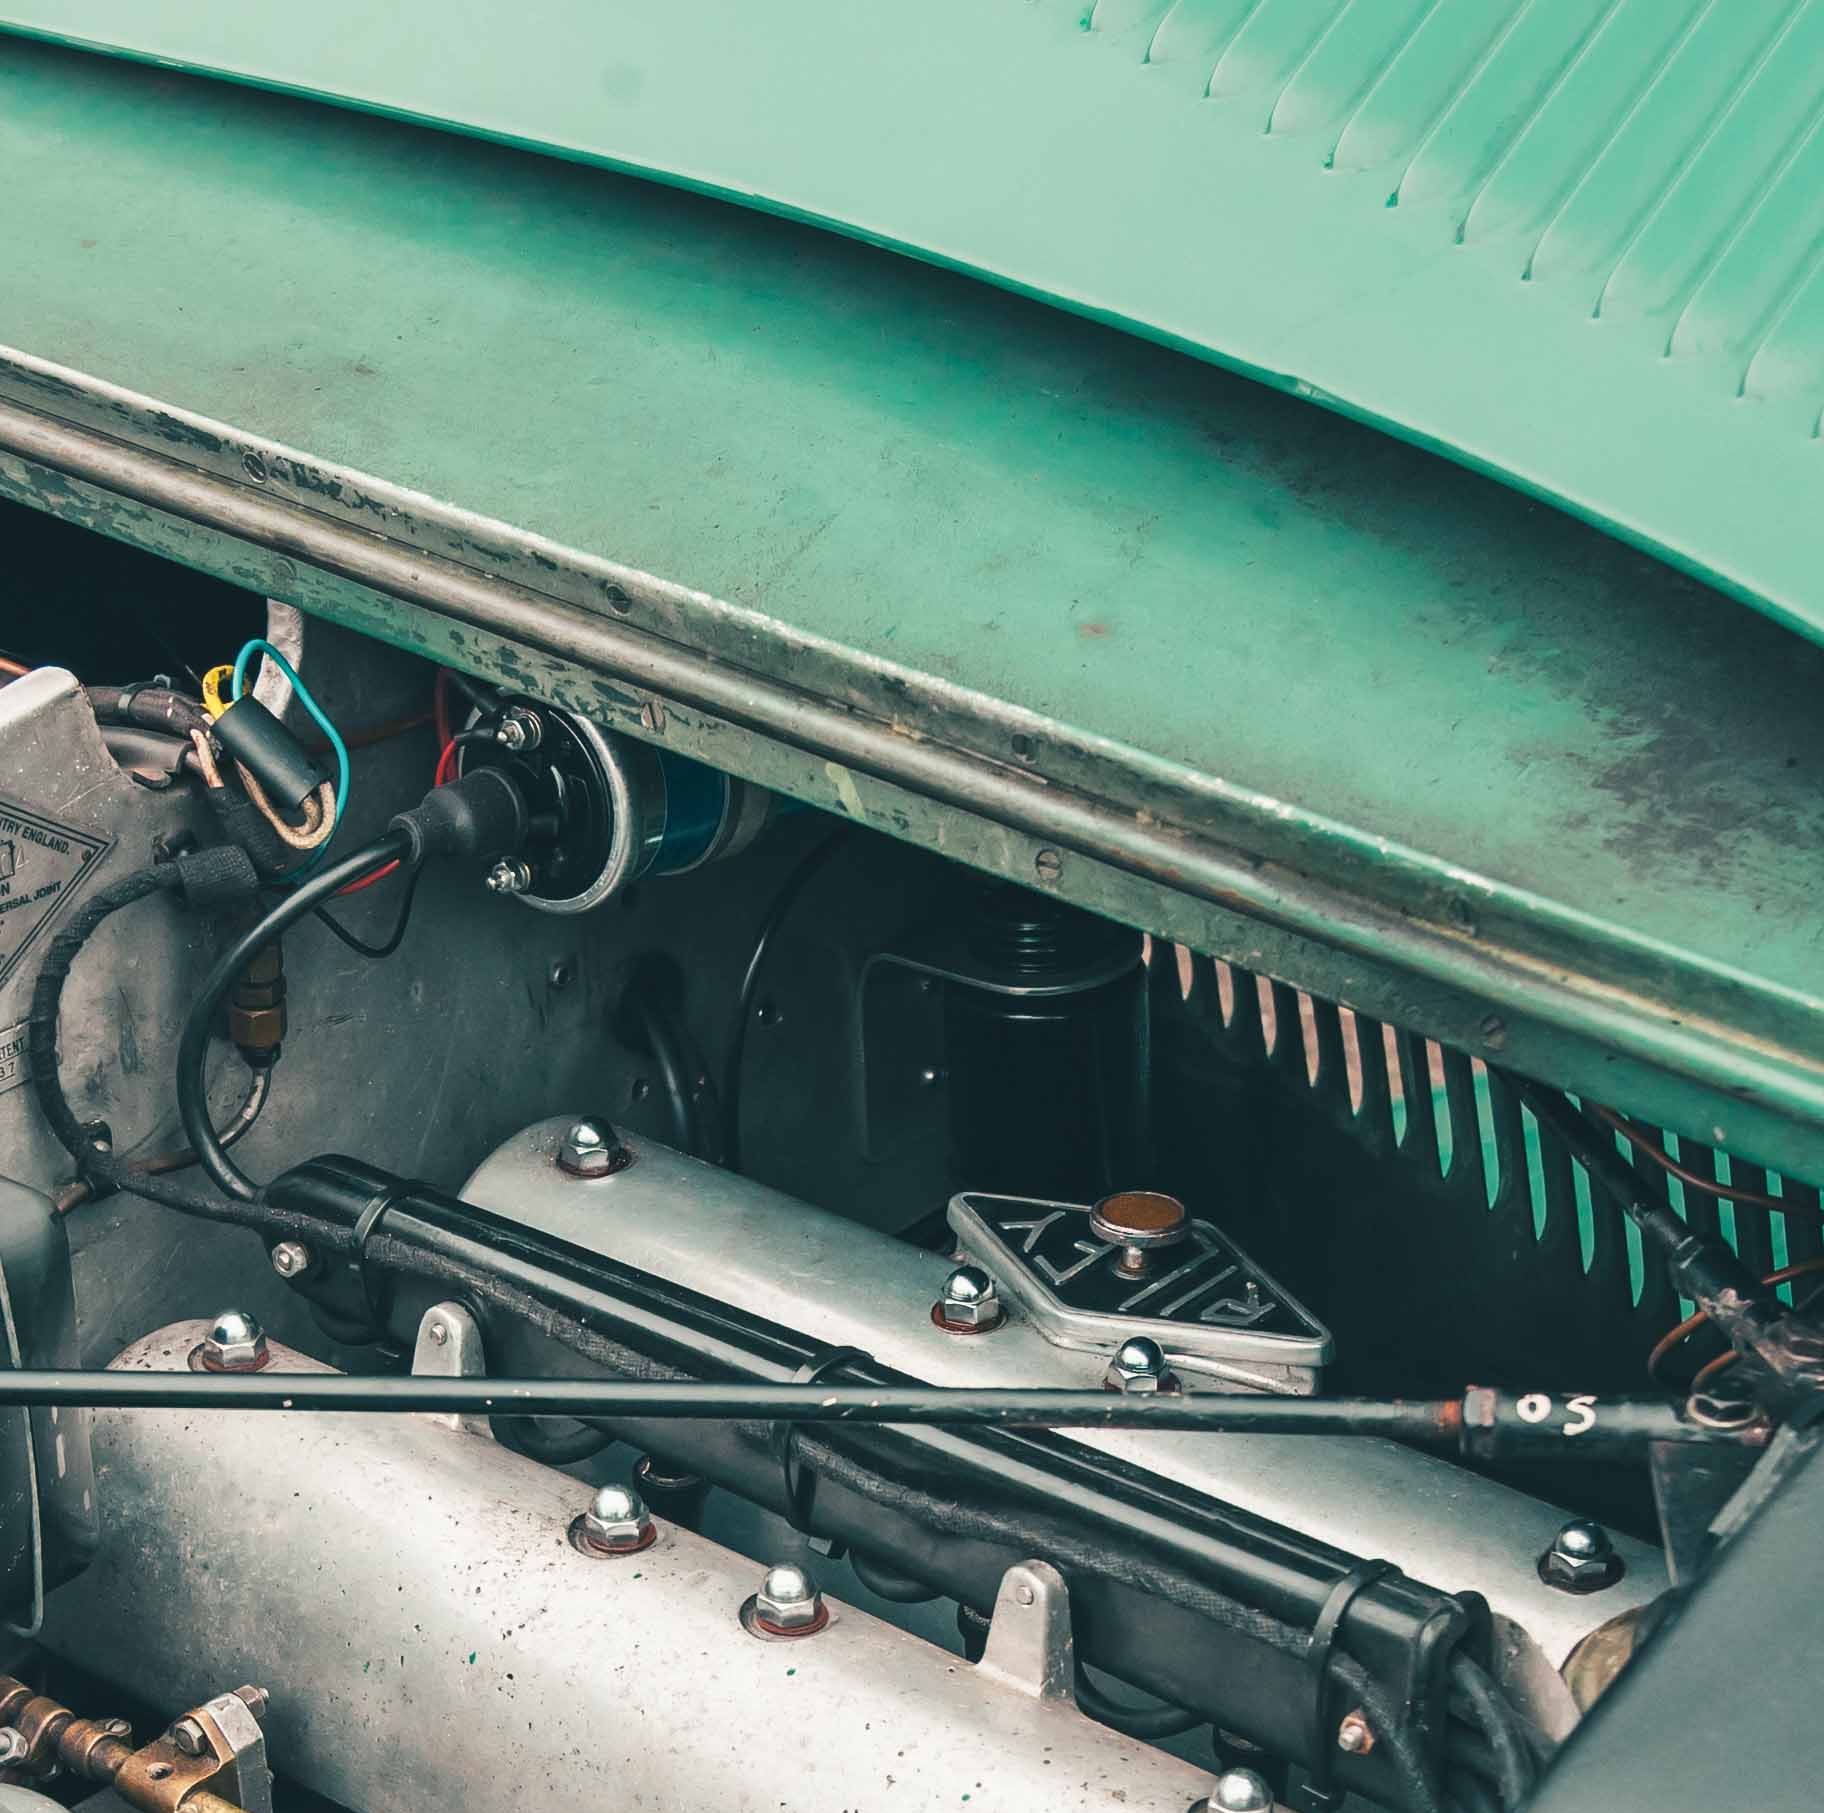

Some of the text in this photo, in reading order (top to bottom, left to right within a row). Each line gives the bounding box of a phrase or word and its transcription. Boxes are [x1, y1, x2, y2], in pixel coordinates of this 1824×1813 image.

[21, 825, 71, 856] ENGLAND.
[34, 880, 63, 902] JOINT
[998, 1209, 1277, 1326] RILEY
